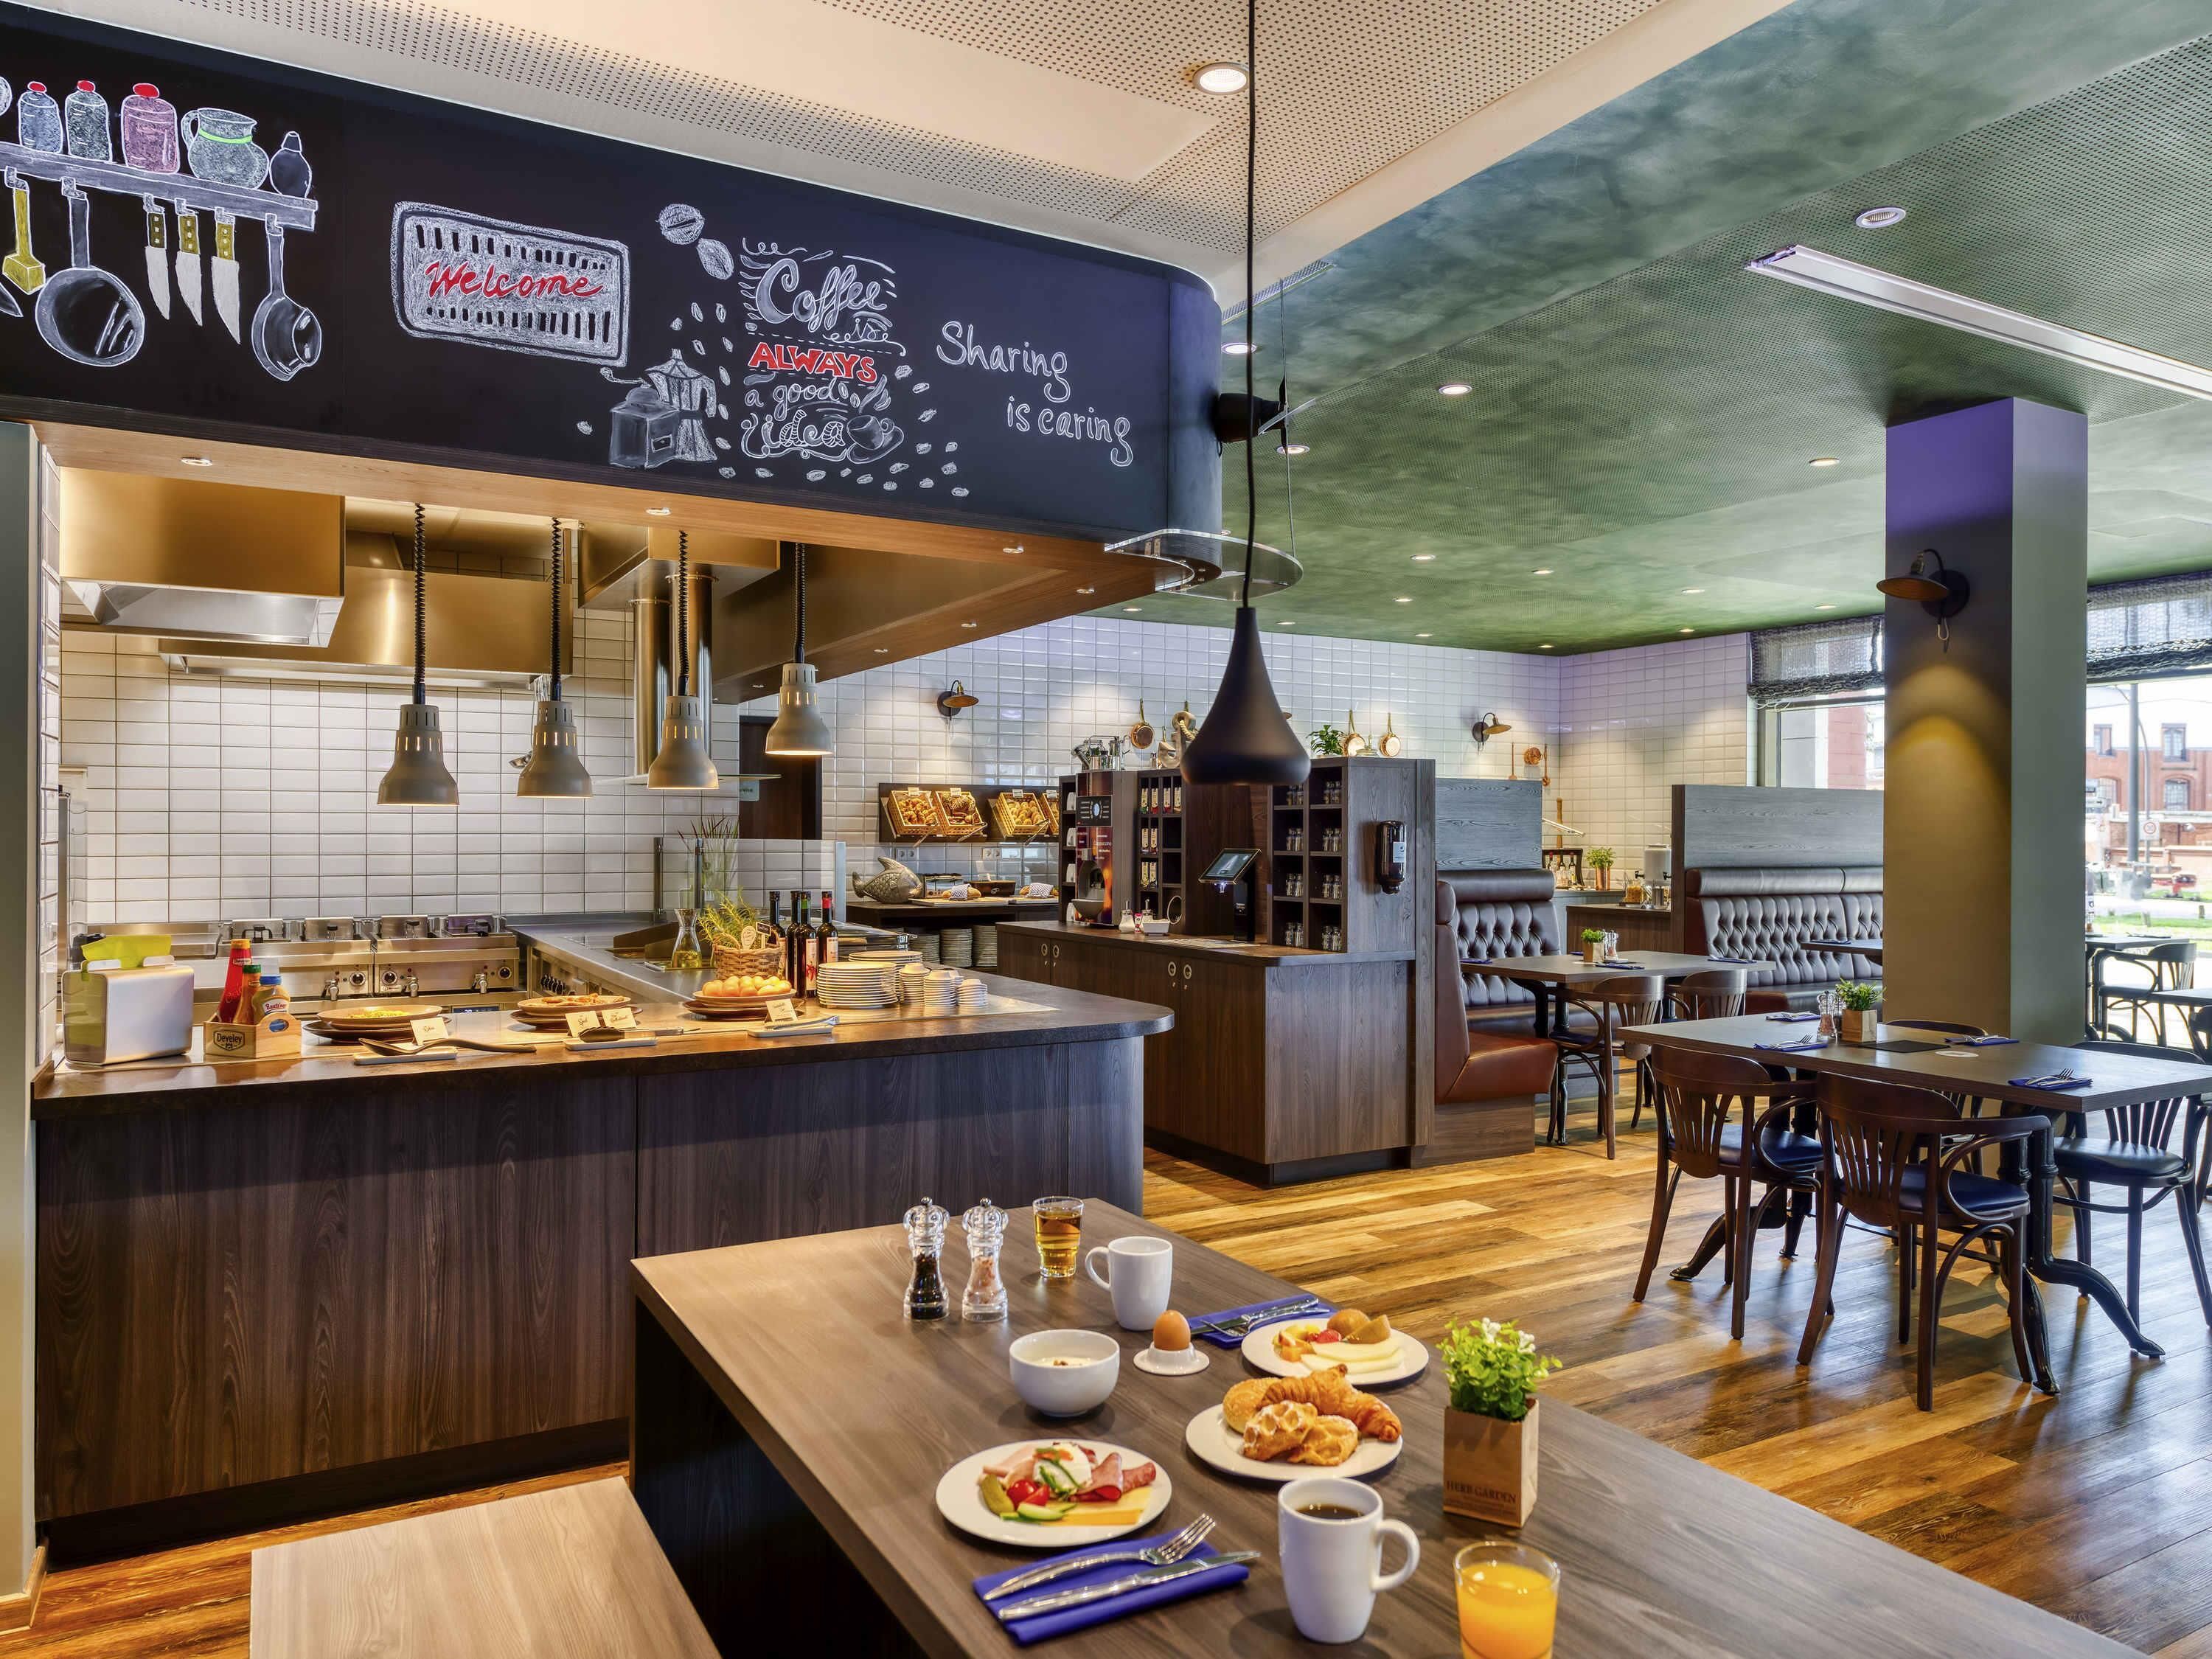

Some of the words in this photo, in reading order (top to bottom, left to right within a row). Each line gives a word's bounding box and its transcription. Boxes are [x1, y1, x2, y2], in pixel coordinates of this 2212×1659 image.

[425, 260, 604, 299] Welcome
[755, 258, 888, 333] Coffee
[748, 341, 877, 383] ALWAYS
[936, 320, 1071, 403] Sharing
[744, 389, 764, 407] a
[772, 377, 840, 421] good
[761, 409, 846, 447] idea
[1007, 396, 1031, 432] is
[1037, 407, 1133, 467] caring
[217, 1034, 242, 1043] Develey
[1474, 1486, 1517, 1503] GARDEN
